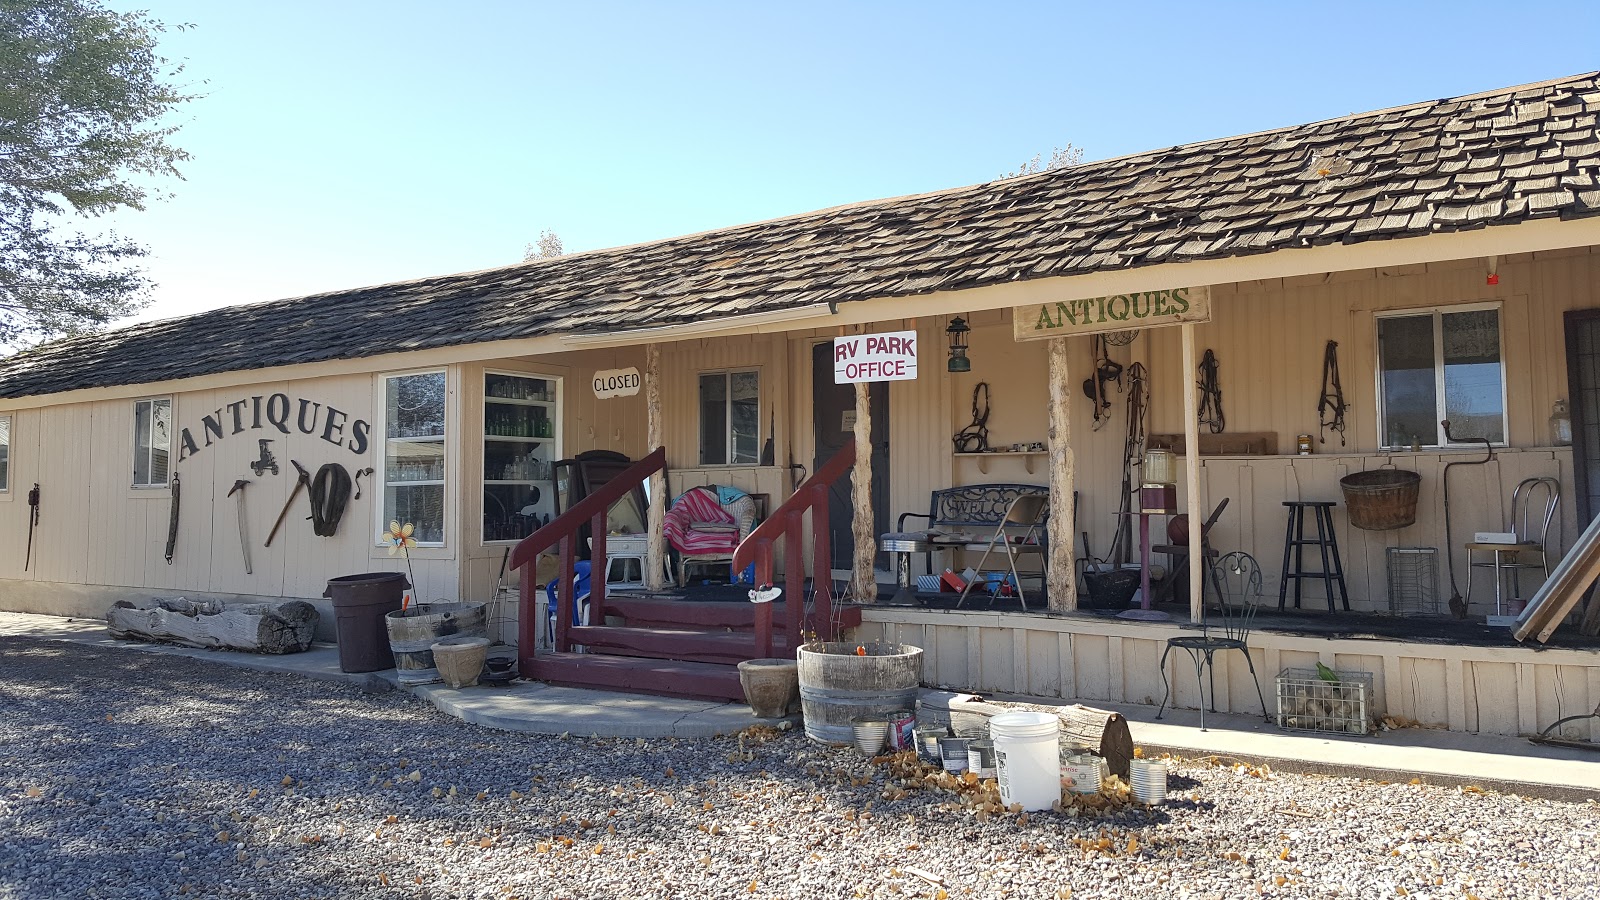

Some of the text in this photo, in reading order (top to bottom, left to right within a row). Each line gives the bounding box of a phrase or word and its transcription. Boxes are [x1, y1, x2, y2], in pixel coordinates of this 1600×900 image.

[1034, 287, 1190, 330] ANTIQUES
[835, 336, 916, 363] RV PARK
[594, 373, 640, 392] CLOSED
[845, 360, 906, 379] OFFICE
[178, 393, 371, 463] ANTIQUES
